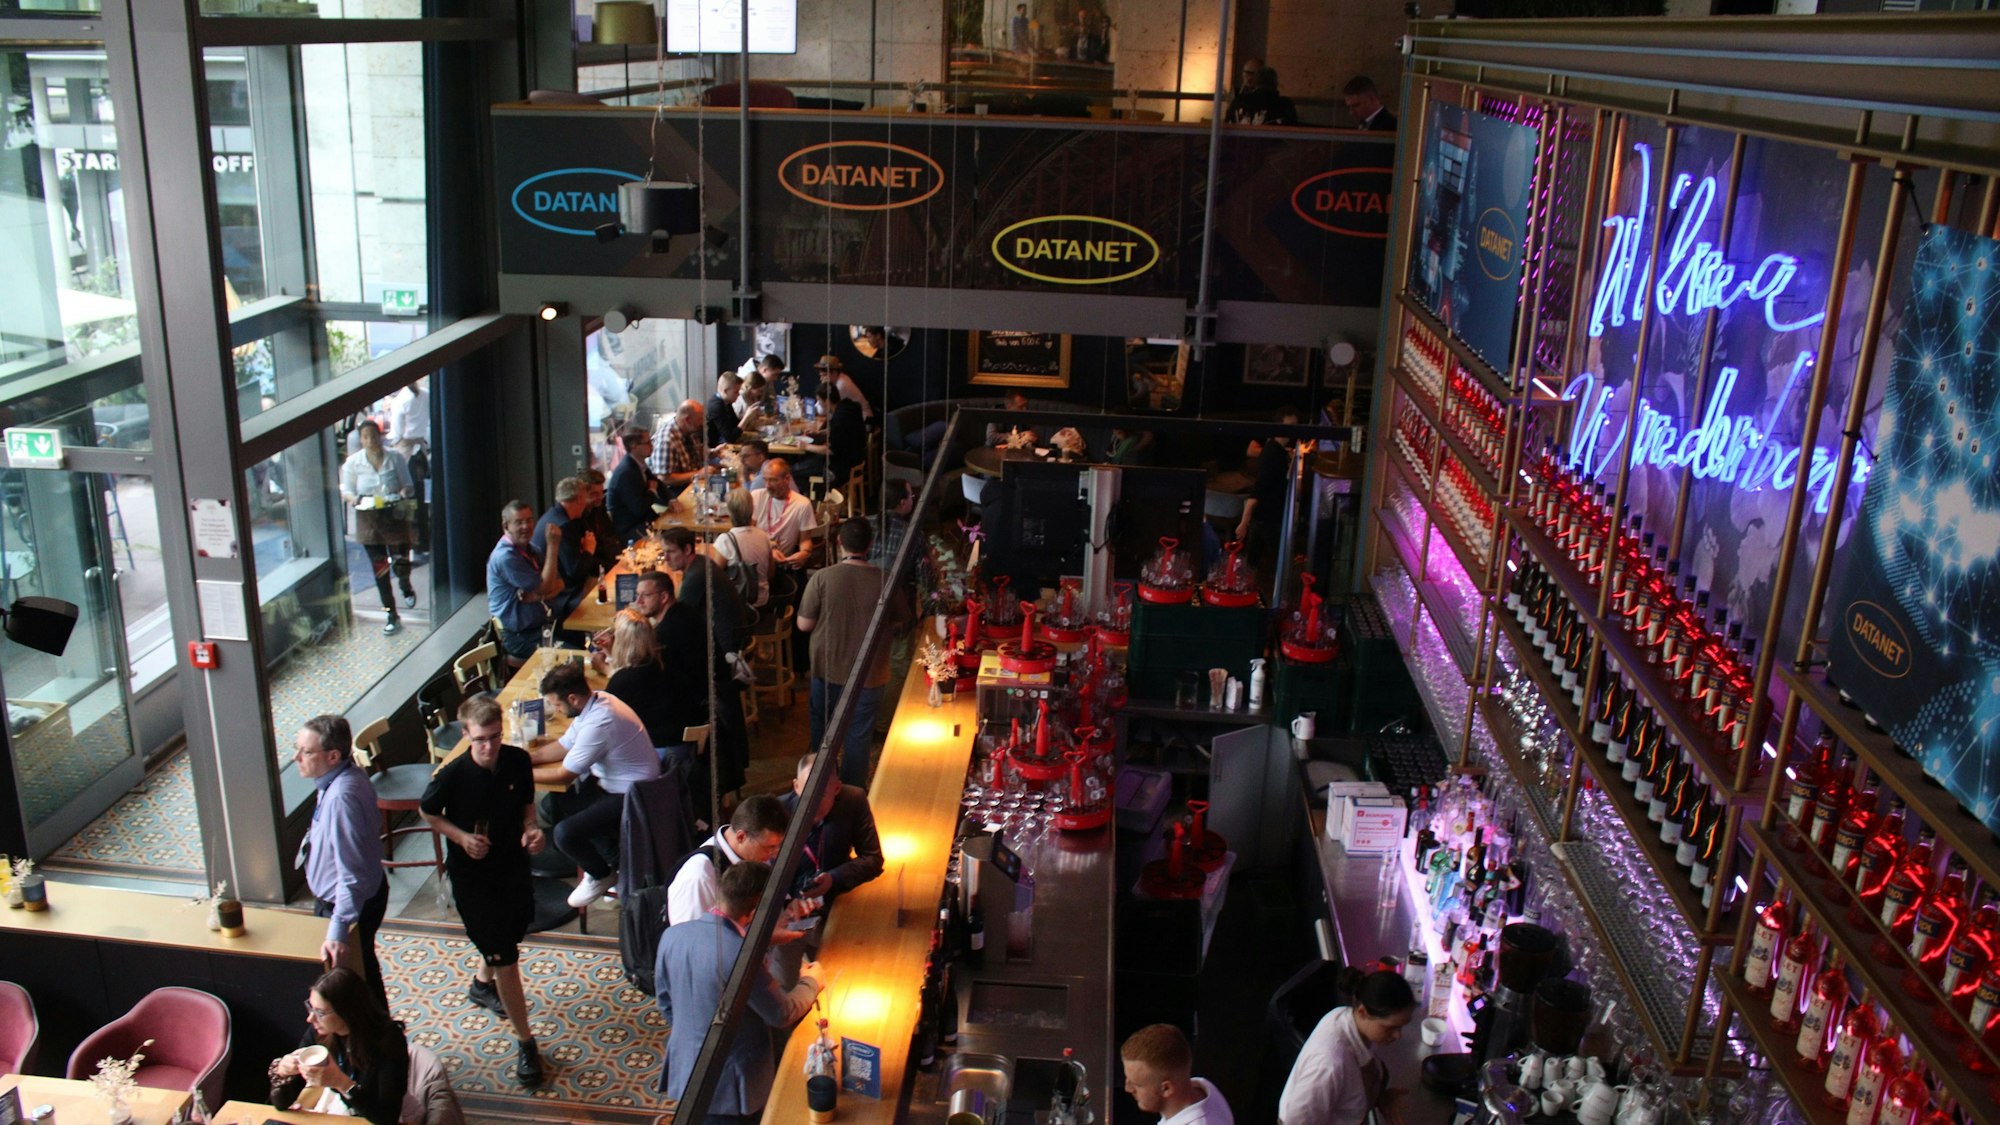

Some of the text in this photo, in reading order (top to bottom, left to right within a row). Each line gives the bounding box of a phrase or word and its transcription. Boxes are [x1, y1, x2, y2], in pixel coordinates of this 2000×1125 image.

[57, 153, 120, 170] STAR
[802, 164, 922, 188] DATANET
[534, 191, 620, 212] DATAN
[1016, 238, 1138, 262] DATANET
[1481, 226, 1513, 262] DATANET
[1852, 612, 1905, 666] DATANET
